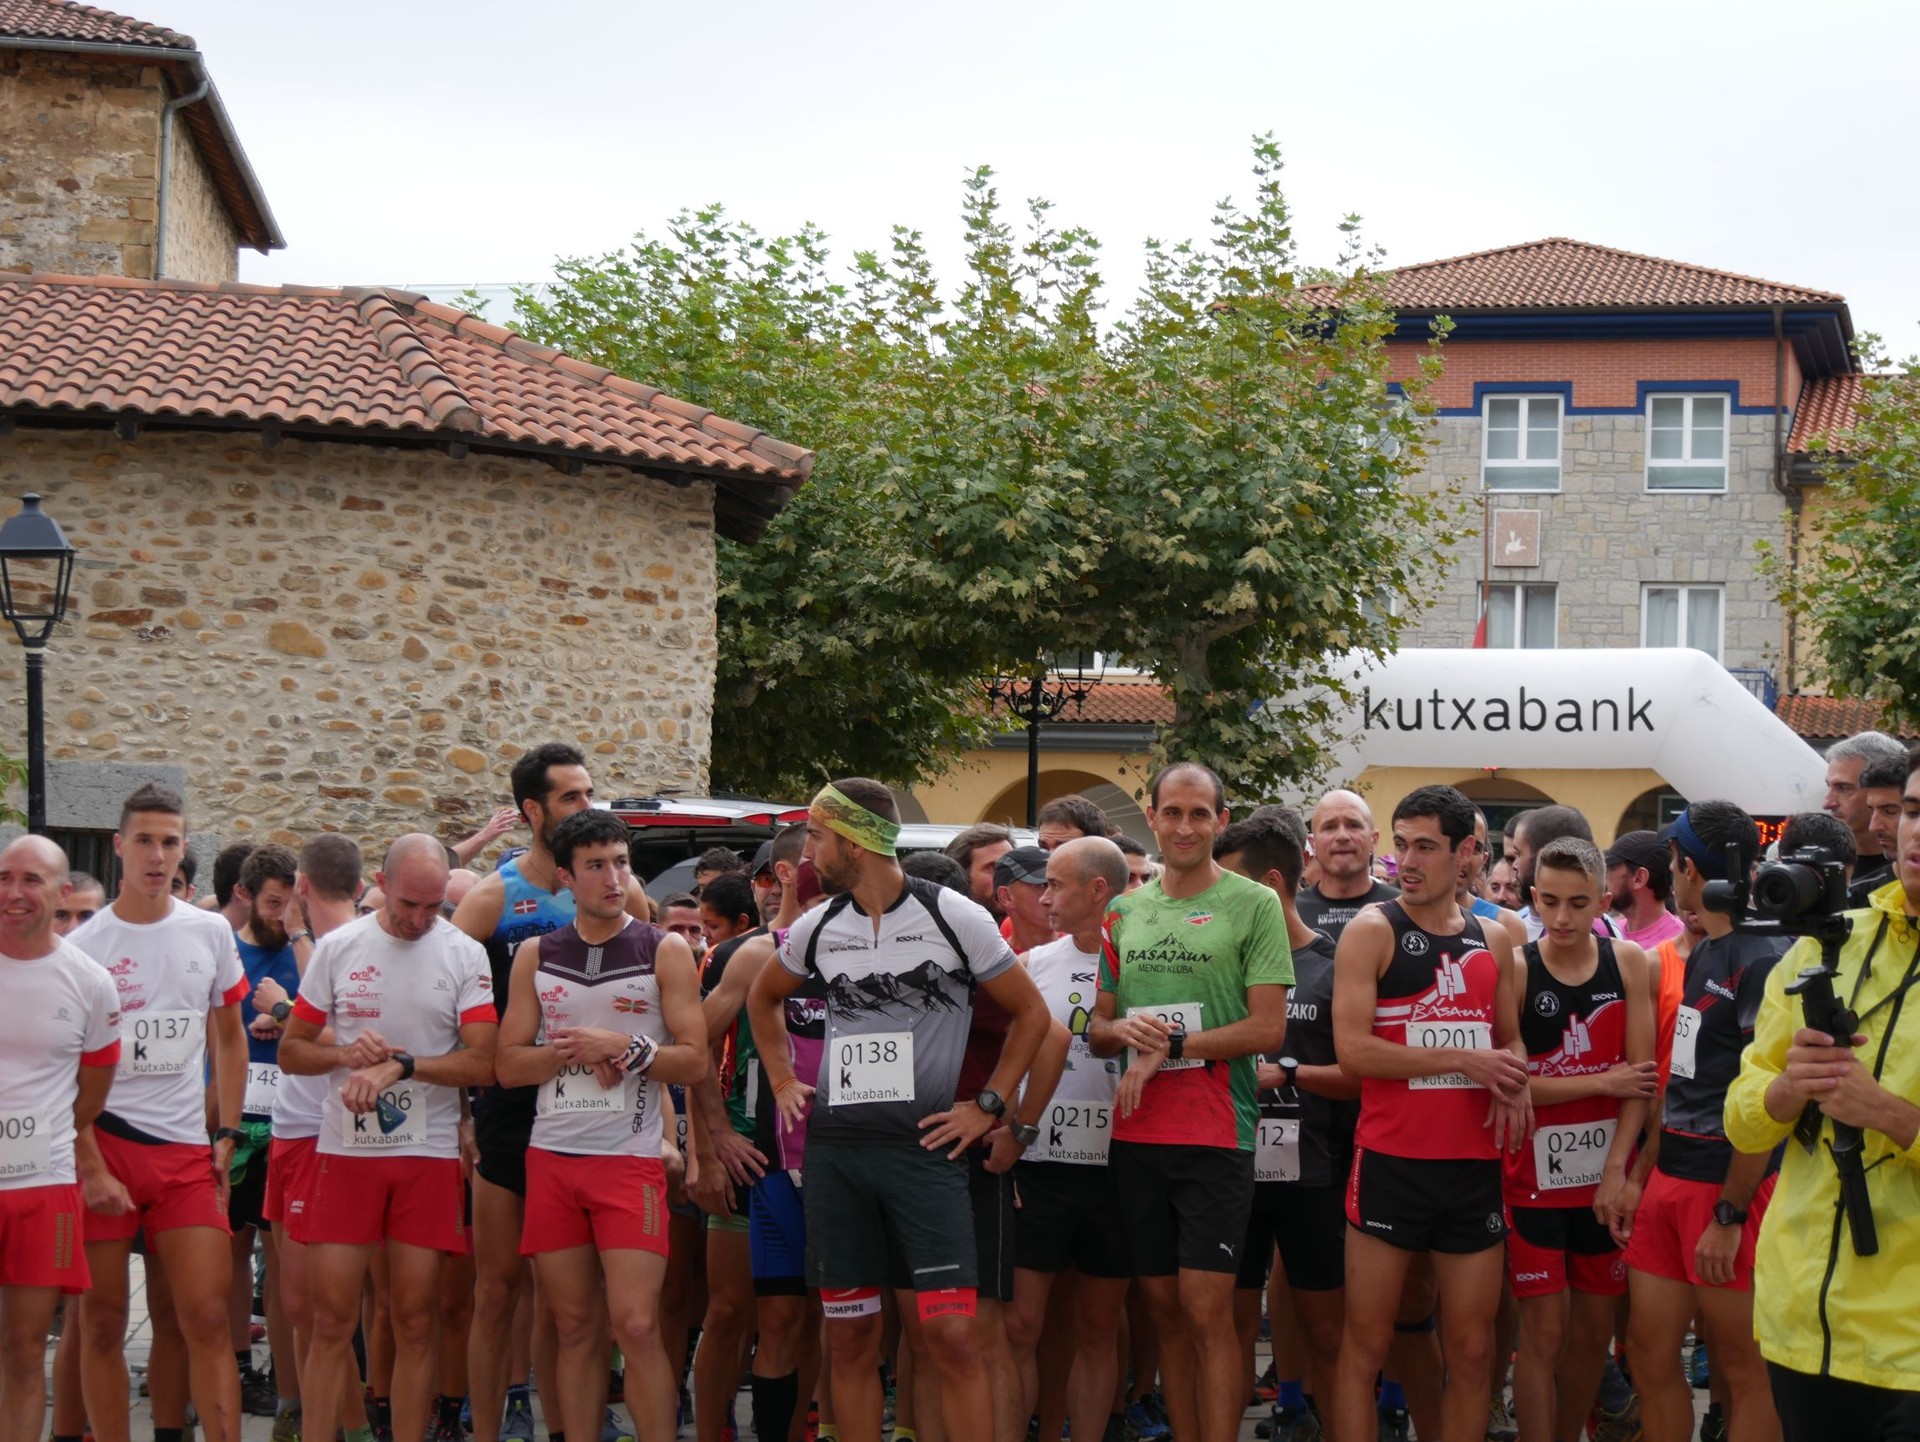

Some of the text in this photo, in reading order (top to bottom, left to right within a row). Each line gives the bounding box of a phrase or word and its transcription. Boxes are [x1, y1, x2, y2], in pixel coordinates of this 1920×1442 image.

[1363, 686, 1655, 733] kutxabank
[1125, 949, 1213, 965] BASAJAUN
[134, 1017, 191, 1041] 0137
[1422, 1028, 1477, 1050] 0201
[134, 1040, 148, 1060] k
[841, 1040, 898, 1066] 0138
[555, 1078, 566, 1099] k
[841, 1066, 853, 1089] k
[553, 1097, 611, 1111] kutxabank
[840, 1086, 900, 1102] kutxabank
[1051, 1105, 1109, 1129] 0215
[353, 1133, 414, 1146] kutxabank
[1049, 1125, 1063, 1147] k
[1547, 1127, 1607, 1154] 0240
[1048, 1147, 1109, 1161] kutxabank
[1548, 1153, 1563, 1175] k
